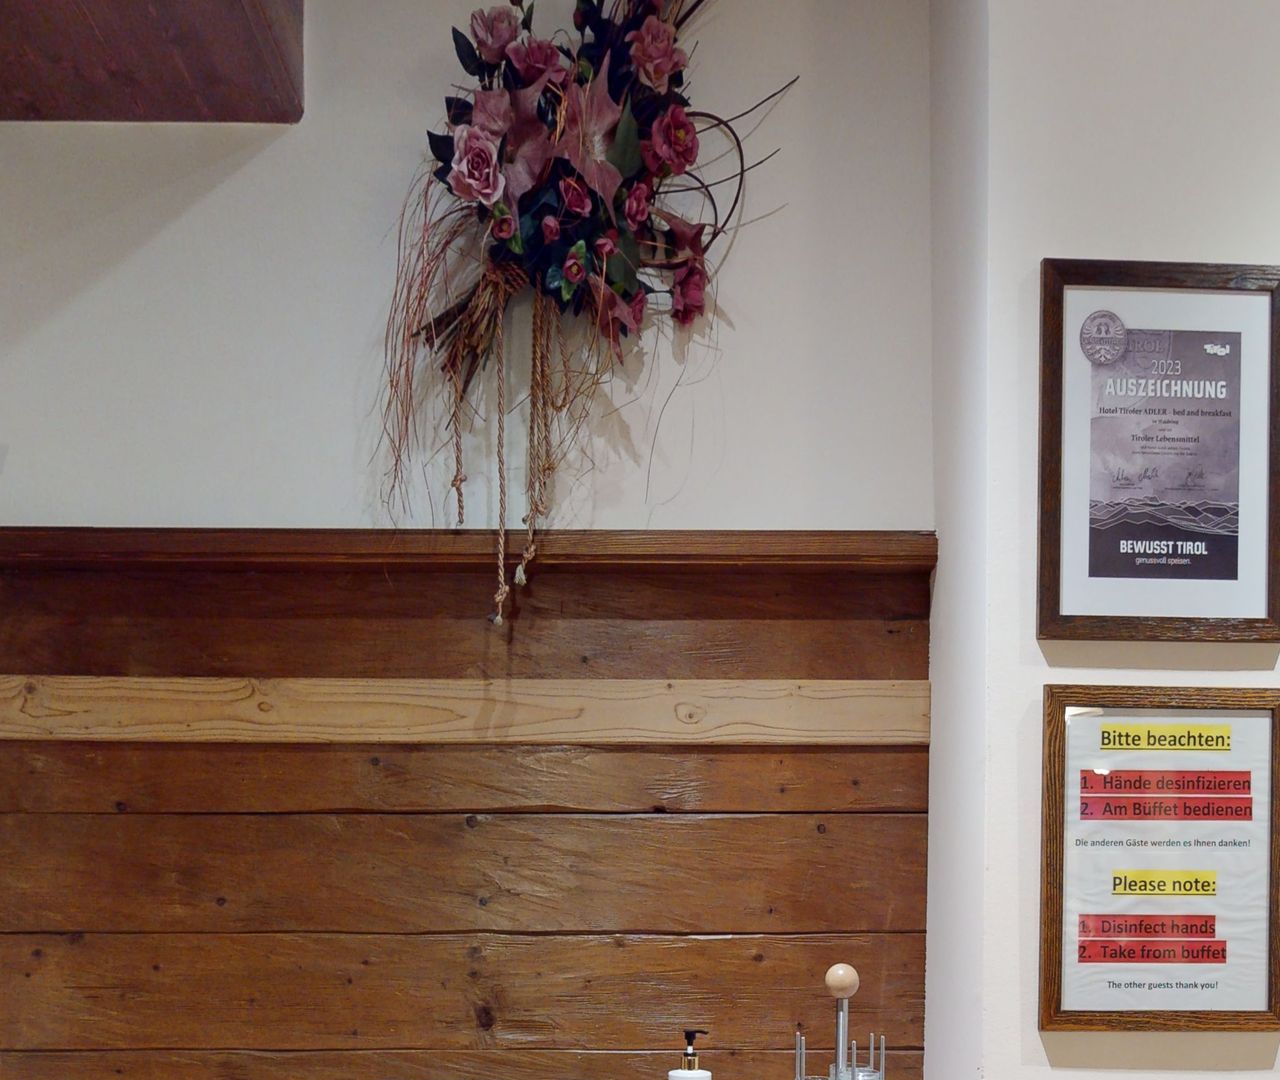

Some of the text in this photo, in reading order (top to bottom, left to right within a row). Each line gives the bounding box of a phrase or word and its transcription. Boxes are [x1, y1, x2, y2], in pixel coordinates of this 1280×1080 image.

[1151, 360, 1182, 375] 2023
[1105, 378, 1227, 399] AUSZEICHNUNG
[1099, 407, 1118, 415] Hotel
[1143, 408, 1167, 416] ADLER
[1172, 408, 1186, 416] bed
[1200, 409, 1232, 417] breakfast
[1131, 434, 1200, 443] Tiroler Lebensmittel
[1120, 540, 1208, 555] BEWUSST TIROL
[1101, 730, 1231, 747] Bitte beachten:
[1081, 776, 1251, 790] 1. Hände desinfizieren
[1080, 802, 1252, 816] 2. Am Büffet bedienen
[1075, 838, 1088, 847] Die
[1090, 838, 1123, 847] anderen
[1125, 838, 1149, 847] Gäste
[1151, 838, 1181, 847] werden
[1194, 838, 1216, 847] Ihnen
[1218, 838, 1251, 847] danken!
[1112, 876, 1216, 892] Please note:
[1080, 920, 1216, 934] 1. Disinfect hands
[1079, 945, 1227, 959] 2. Take from buffet
[1107, 981, 1218, 991] The other guests thank you!
